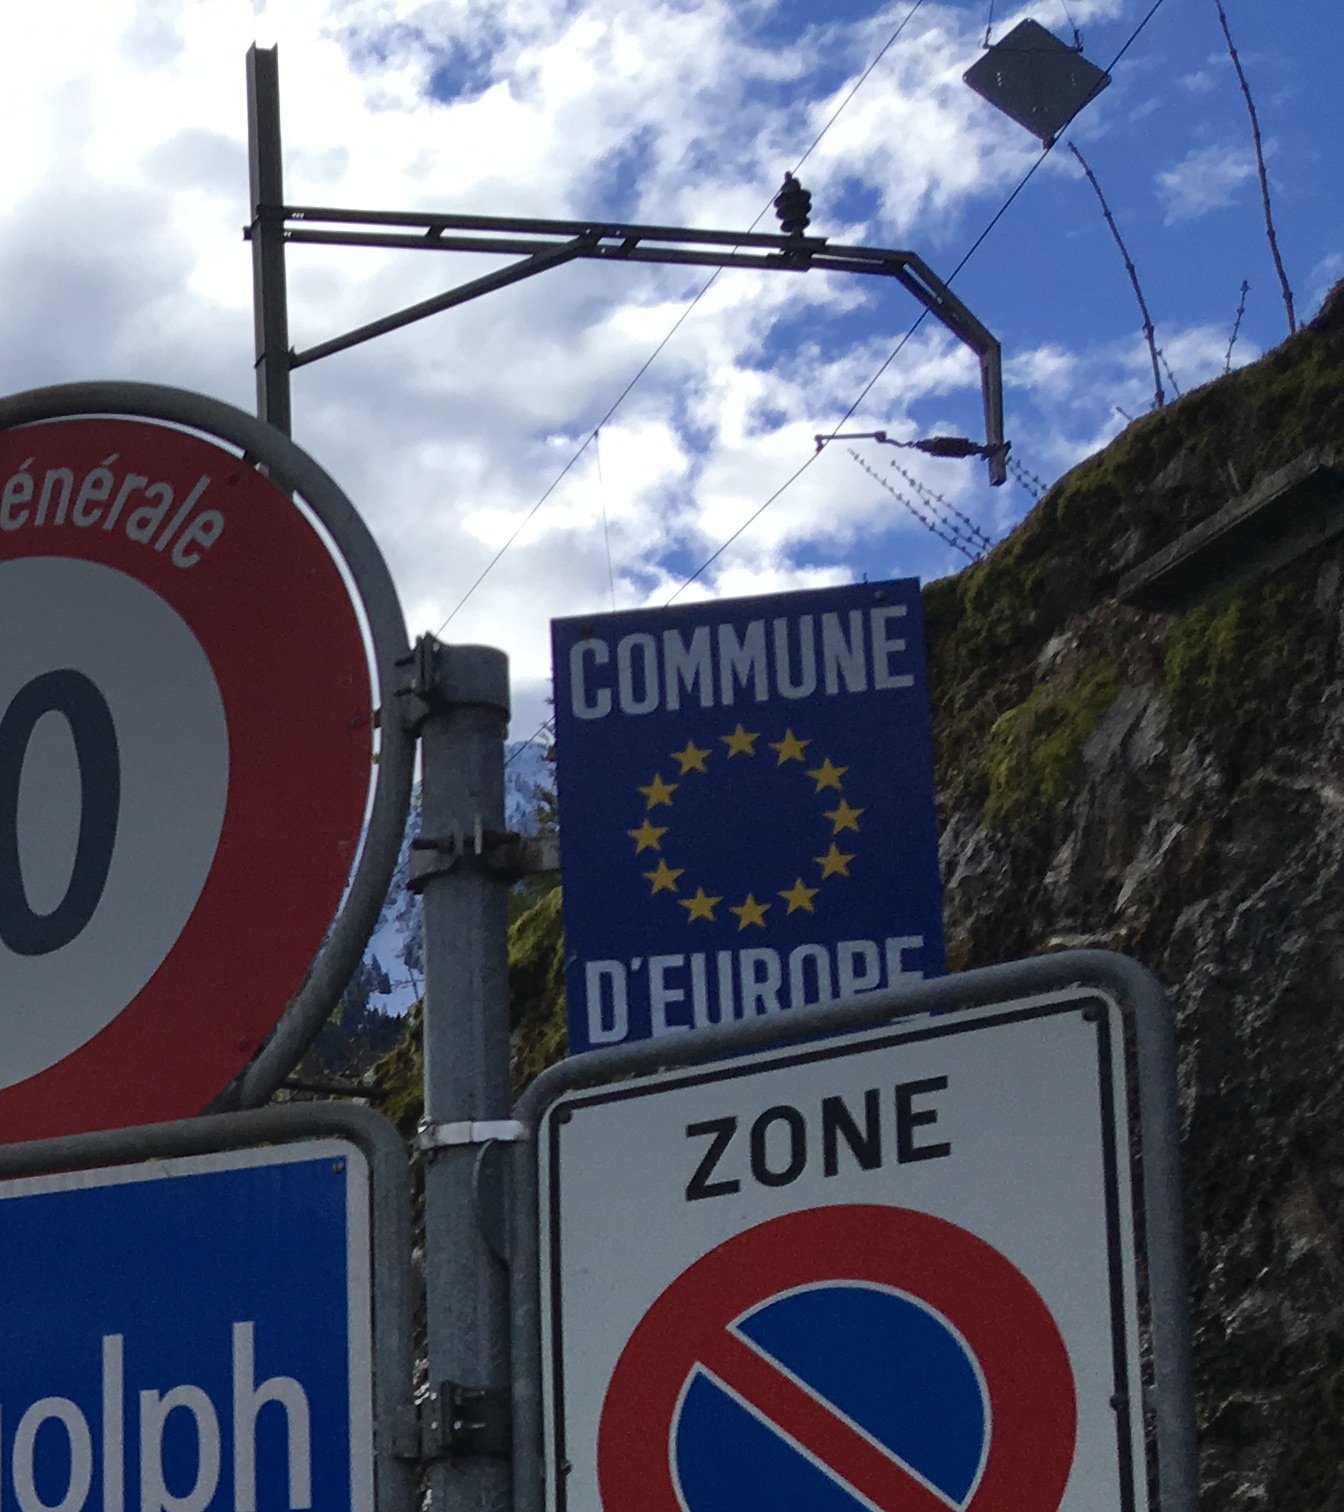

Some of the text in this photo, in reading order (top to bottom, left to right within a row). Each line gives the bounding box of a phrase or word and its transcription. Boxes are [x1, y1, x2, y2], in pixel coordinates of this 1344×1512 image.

[568, 604, 916, 720] COMMUNE
[584, 934, 927, 1045] D'EUROPE
[685, 1075, 952, 1202] ZONE
